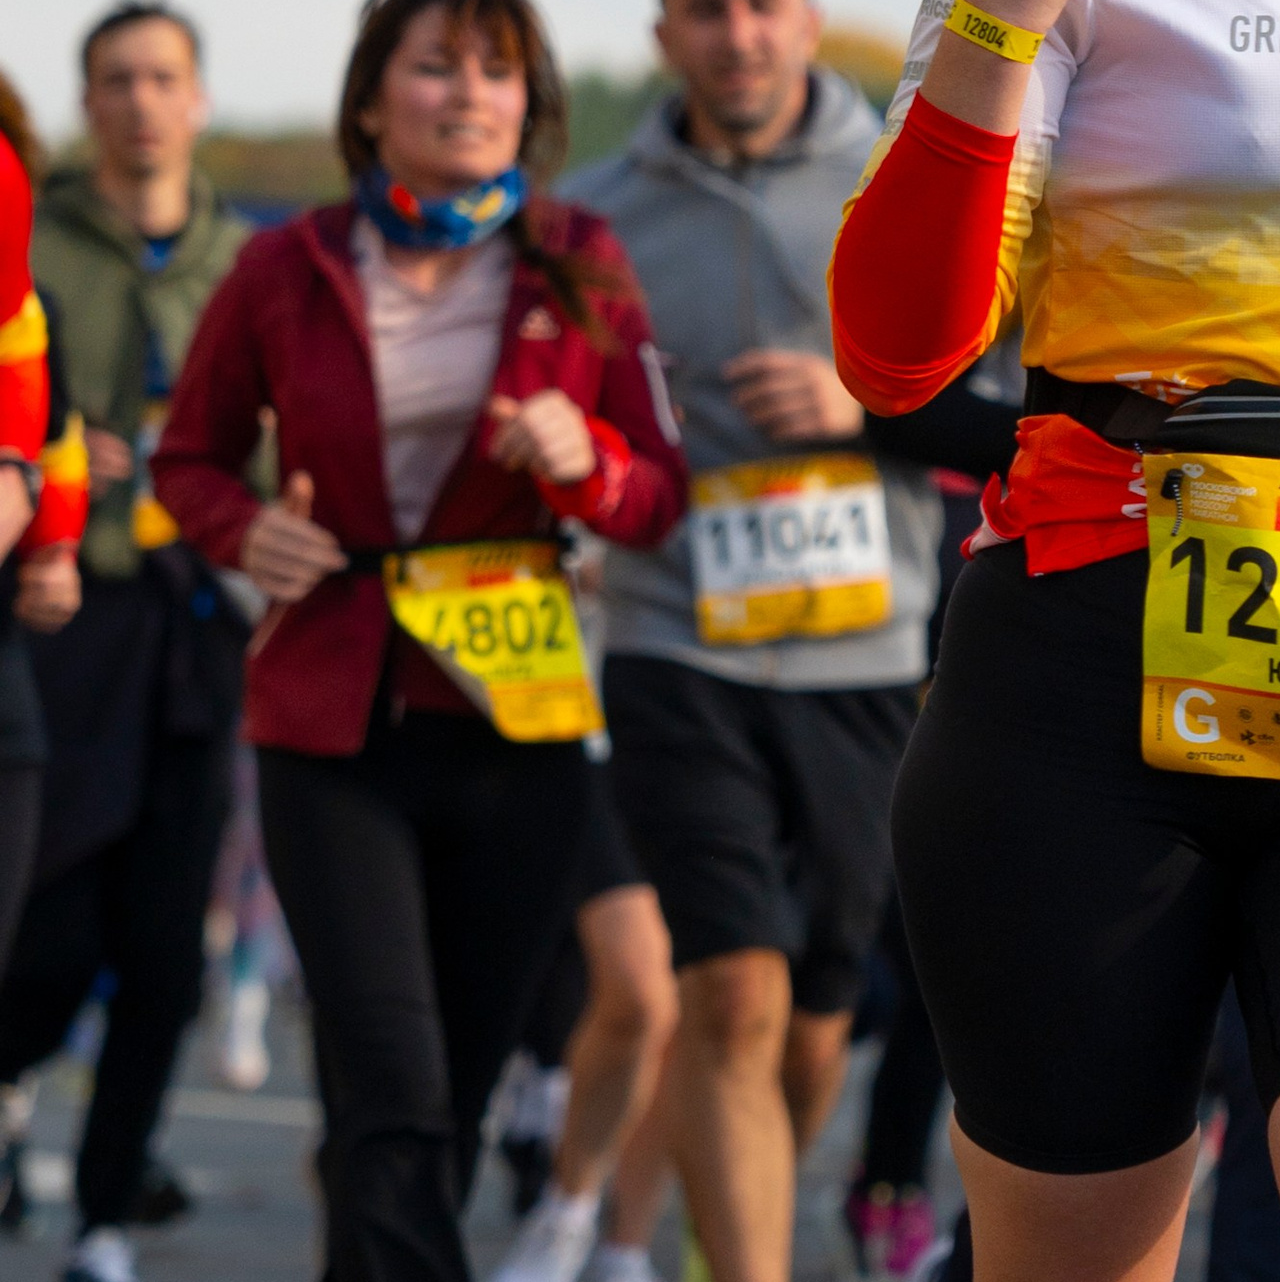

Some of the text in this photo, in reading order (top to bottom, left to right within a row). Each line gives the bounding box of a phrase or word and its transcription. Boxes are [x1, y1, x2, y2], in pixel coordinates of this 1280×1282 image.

[962, 13, 1008, 49] 12804
[709, 501, 872, 570] 11041
[1172, 687, 1222, 744] G
[1185, 751, 1246, 763] ФУТБОЛКА
